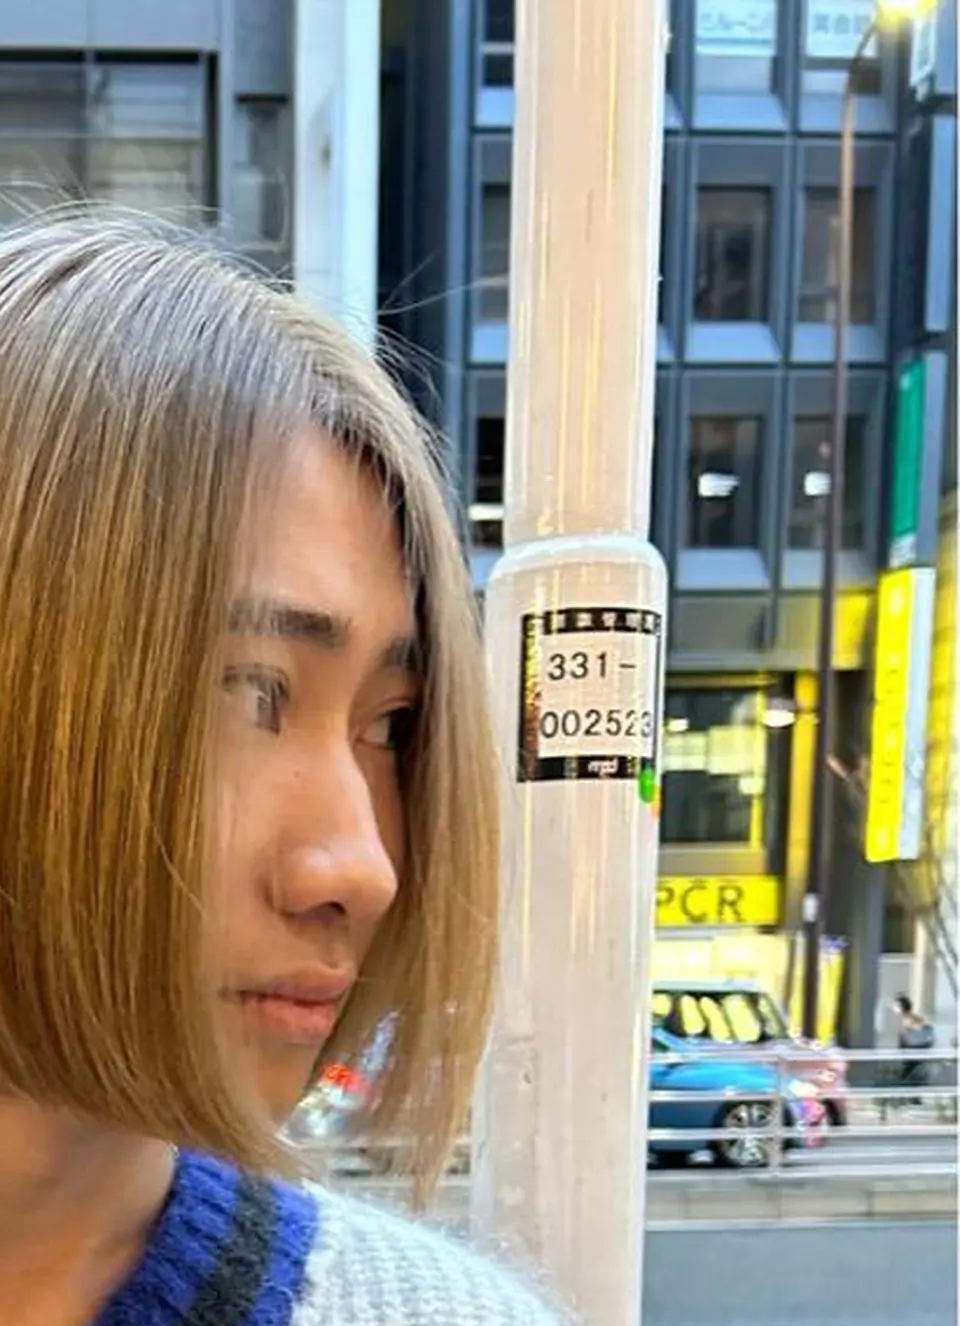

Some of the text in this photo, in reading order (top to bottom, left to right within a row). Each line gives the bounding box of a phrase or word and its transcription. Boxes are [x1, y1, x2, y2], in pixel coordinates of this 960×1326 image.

[547, 651, 637, 681] 331-
[540, 709, 653, 739] 002523
[657, 884, 746, 923] PCR
